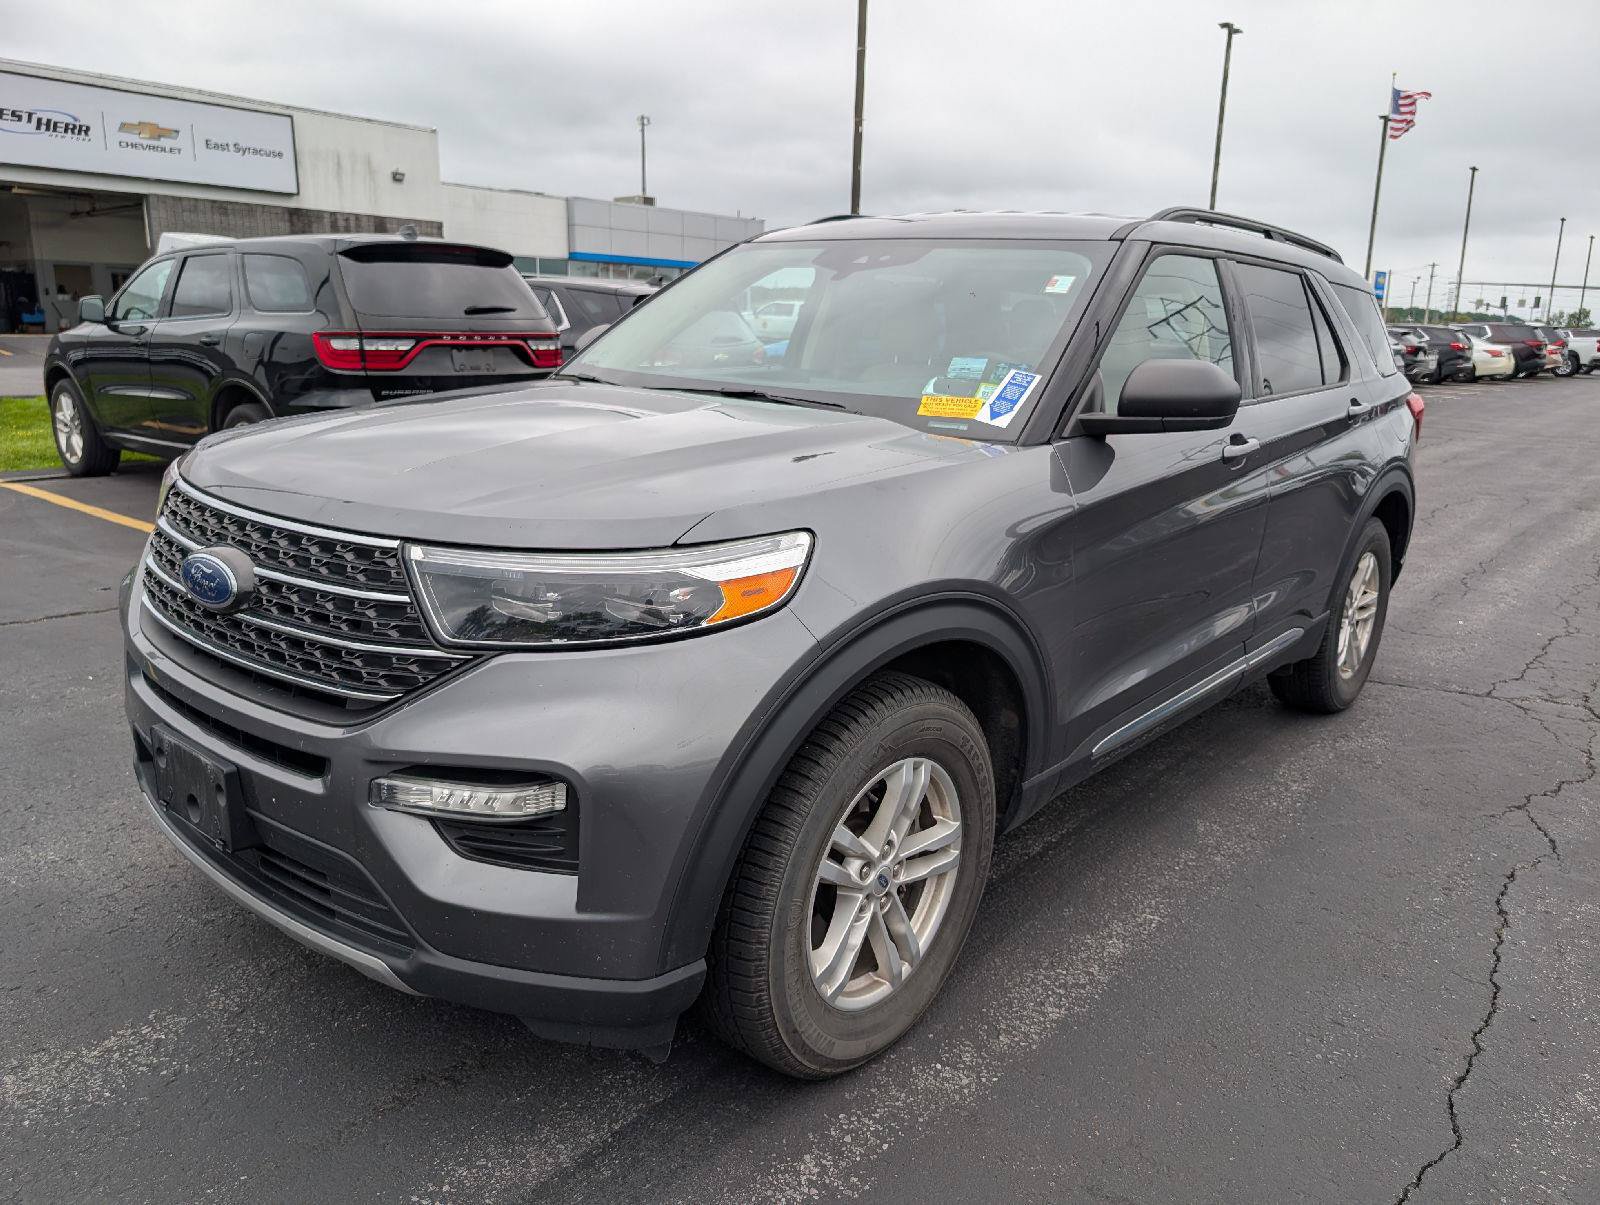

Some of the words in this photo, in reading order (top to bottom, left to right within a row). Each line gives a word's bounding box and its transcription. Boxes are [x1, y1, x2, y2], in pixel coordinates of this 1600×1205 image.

[35, 116, 91, 137] HERR
[119, 140, 182, 155] CHEVROLET
[205, 139, 230, 152] East
[233, 143, 284, 159] Syracuse
